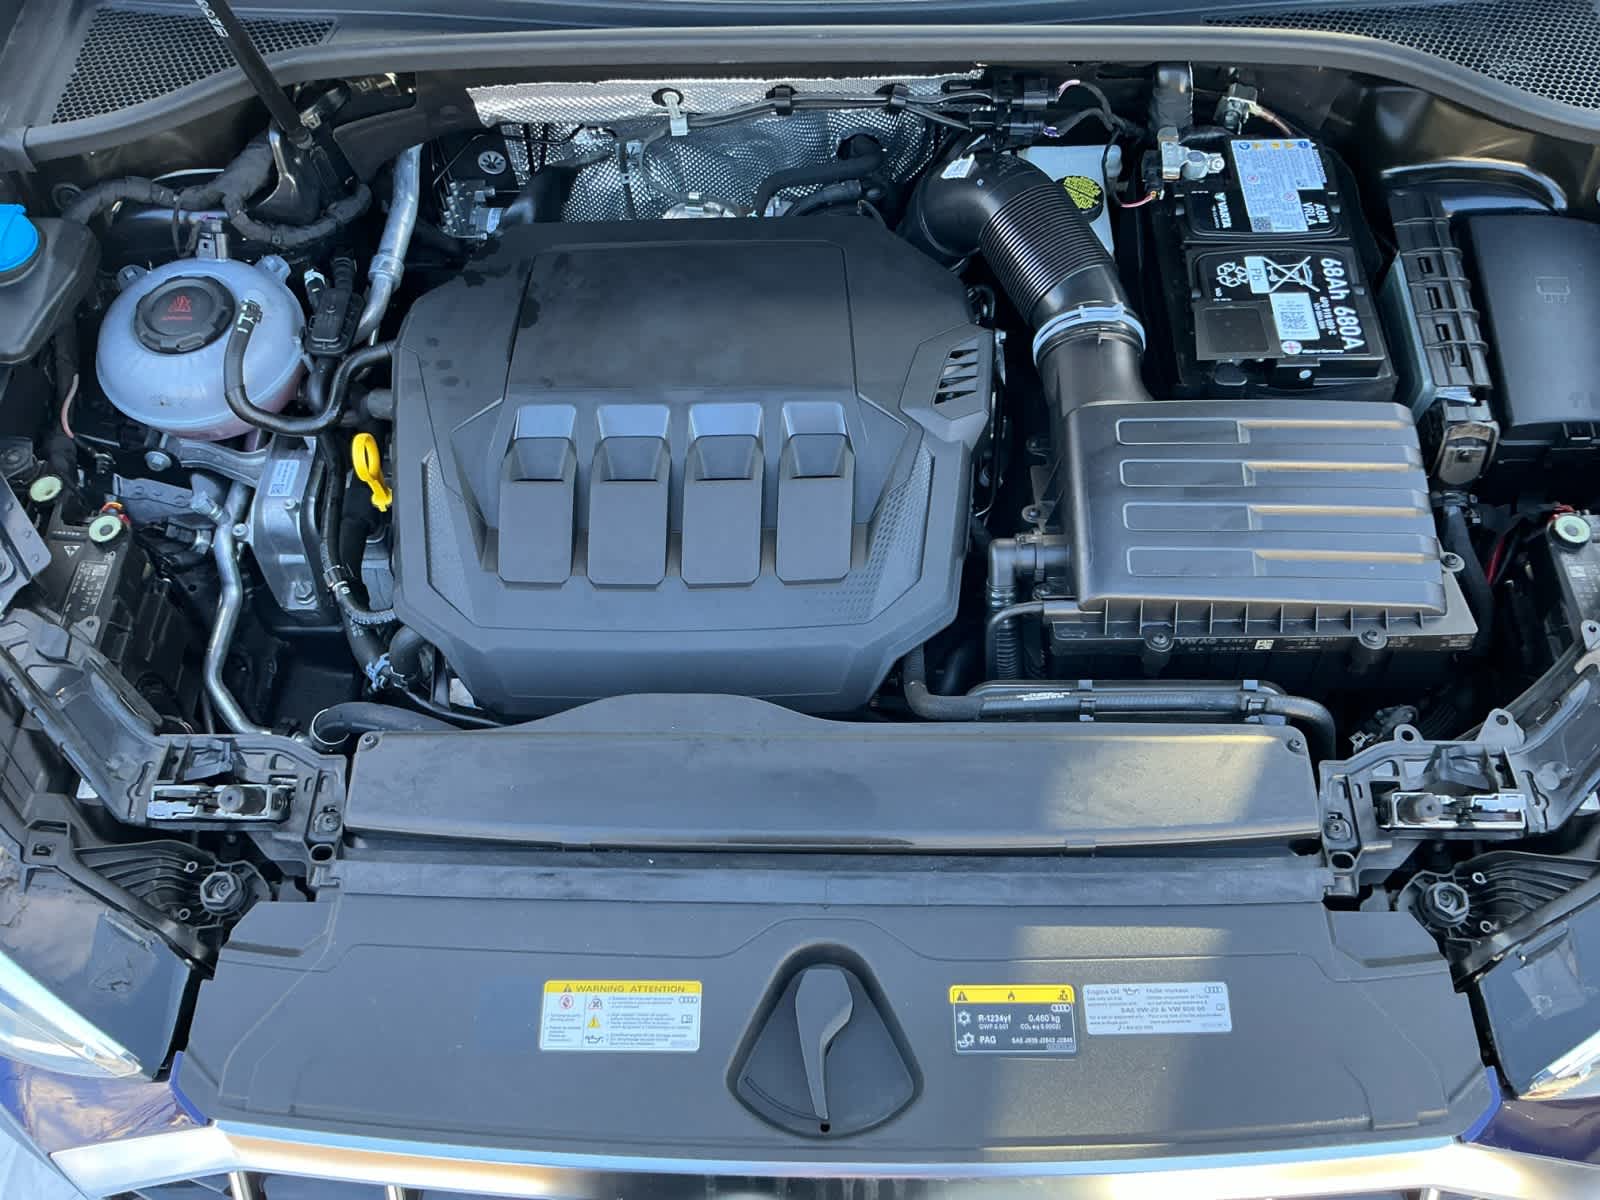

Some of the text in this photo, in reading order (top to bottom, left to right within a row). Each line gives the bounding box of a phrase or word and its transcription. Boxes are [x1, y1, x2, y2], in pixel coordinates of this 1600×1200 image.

[1217, 202, 1232, 228] VARTA
[1302, 202, 1318, 226] VRLA
[1314, 204, 1330, 223] AGM
[1250, 268, 1264, 281] Pb
[1321, 258, 1365, 350] 68Ah 680A
[576, 984, 685, 992] WARNING ATTENTION
[978, 1014, 1012, 1024] R-1234yf
[1050, 1014, 1060, 1024] kg
[980, 1036, 996, 1044] PAG
